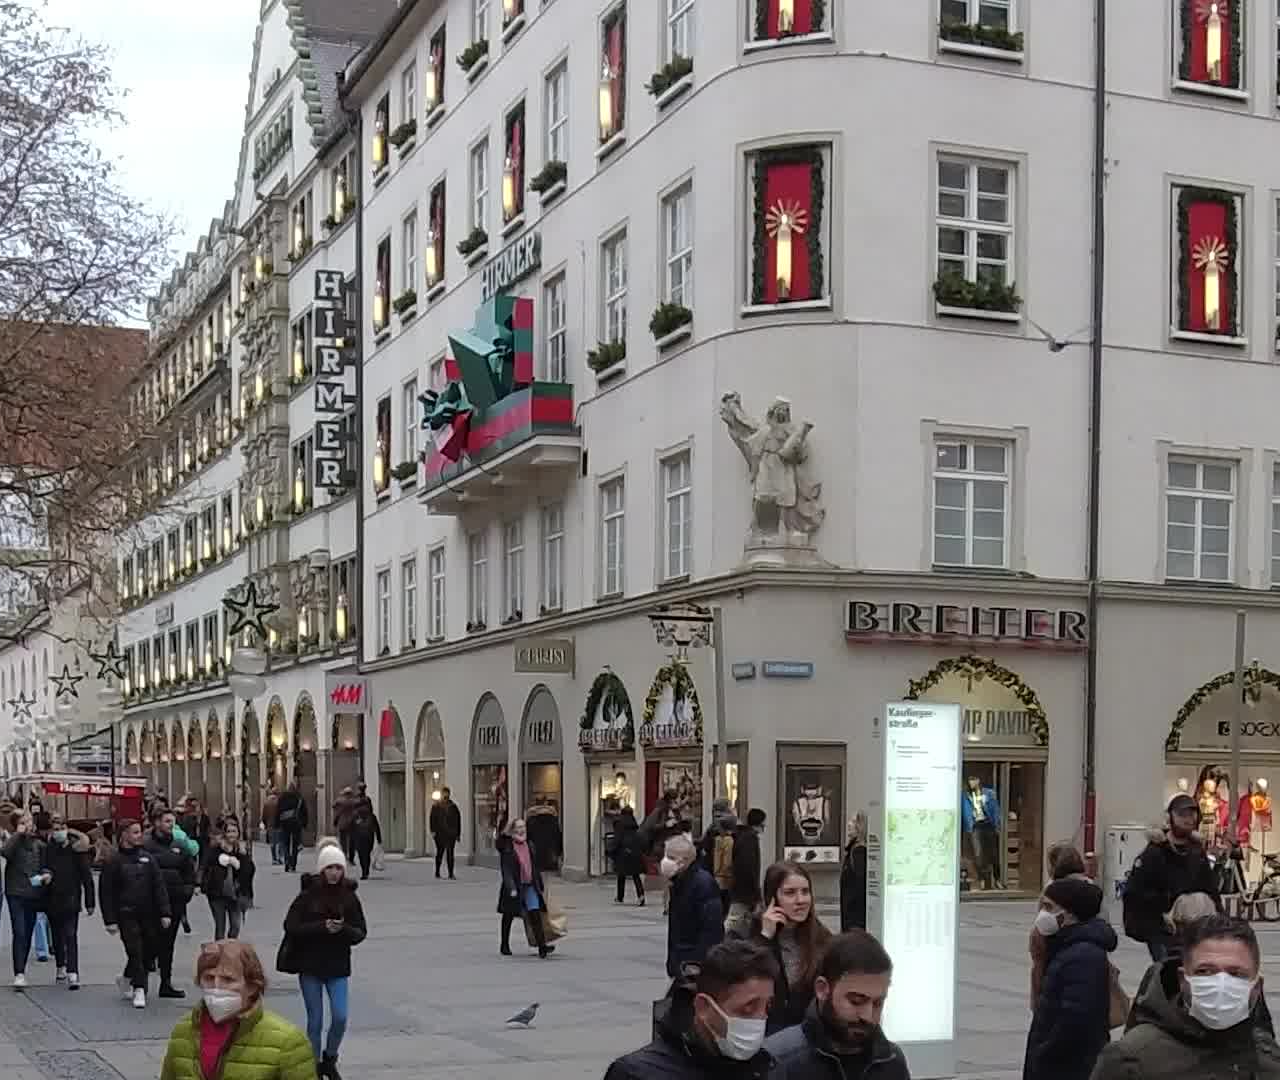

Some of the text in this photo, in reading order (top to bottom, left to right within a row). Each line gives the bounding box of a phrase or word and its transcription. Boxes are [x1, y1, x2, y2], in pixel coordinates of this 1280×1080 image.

[481, 233, 540, 303] HIRMER
[318, 272, 344, 486] HIRMER
[847, 600, 1087, 640] BREITER
[329, 683, 362, 705] H&M
[986, 709, 1032, 736] DAVID
